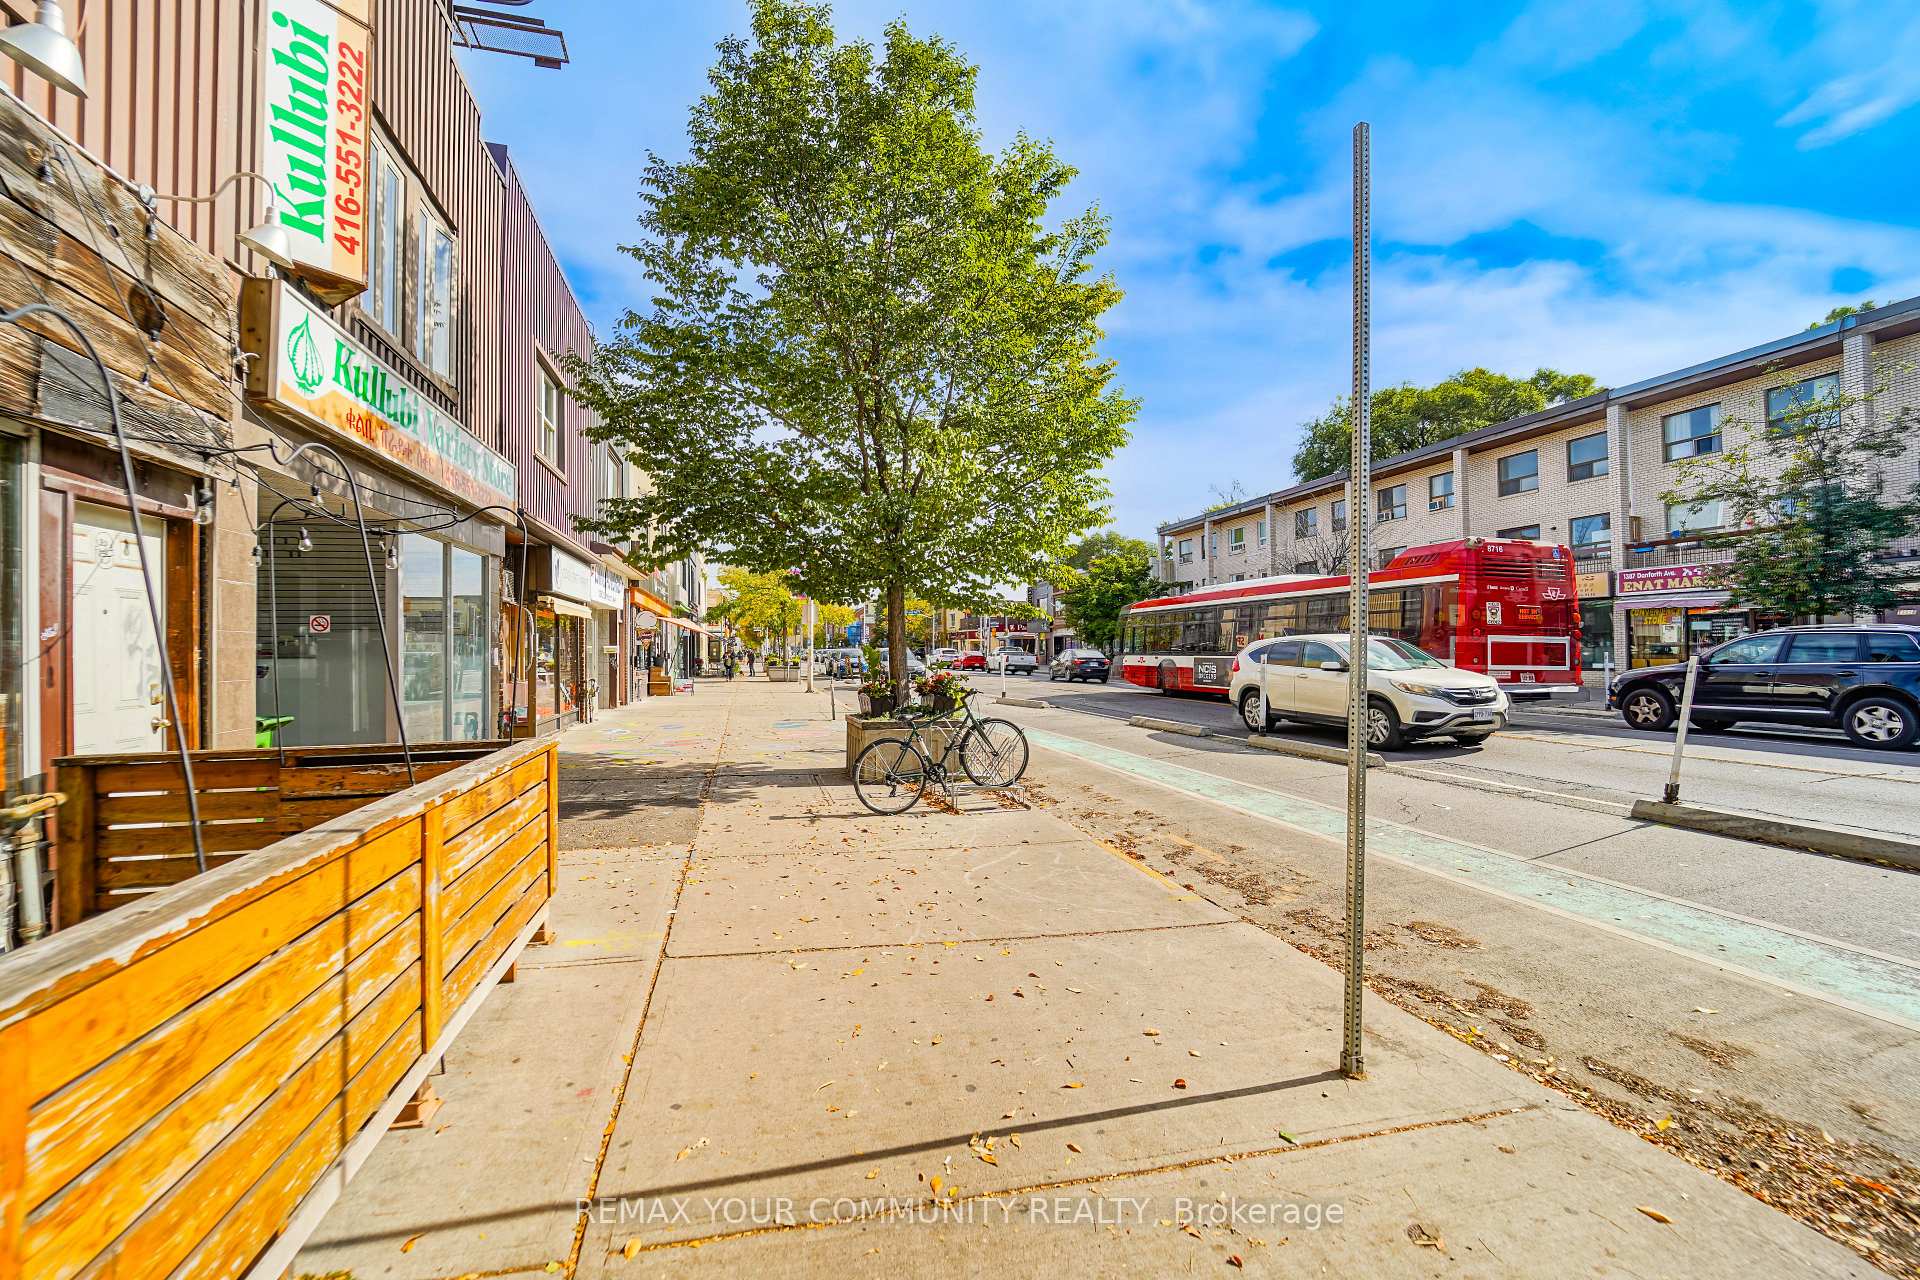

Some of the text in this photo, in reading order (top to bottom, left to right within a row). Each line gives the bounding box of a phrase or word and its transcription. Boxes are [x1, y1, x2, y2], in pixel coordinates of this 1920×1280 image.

[270, 11, 329, 243] Kullubi
[334, 42, 364, 256] 416-551-3222
[332, 338, 512, 496] Kullubi Variety Store
[1487, 545, 1503, 553] 8716
[1636, 571, 1663, 579] Danforth
[1623, 578, 1664, 592] ENAT
[1198, 664, 1217, 674] NCIS
